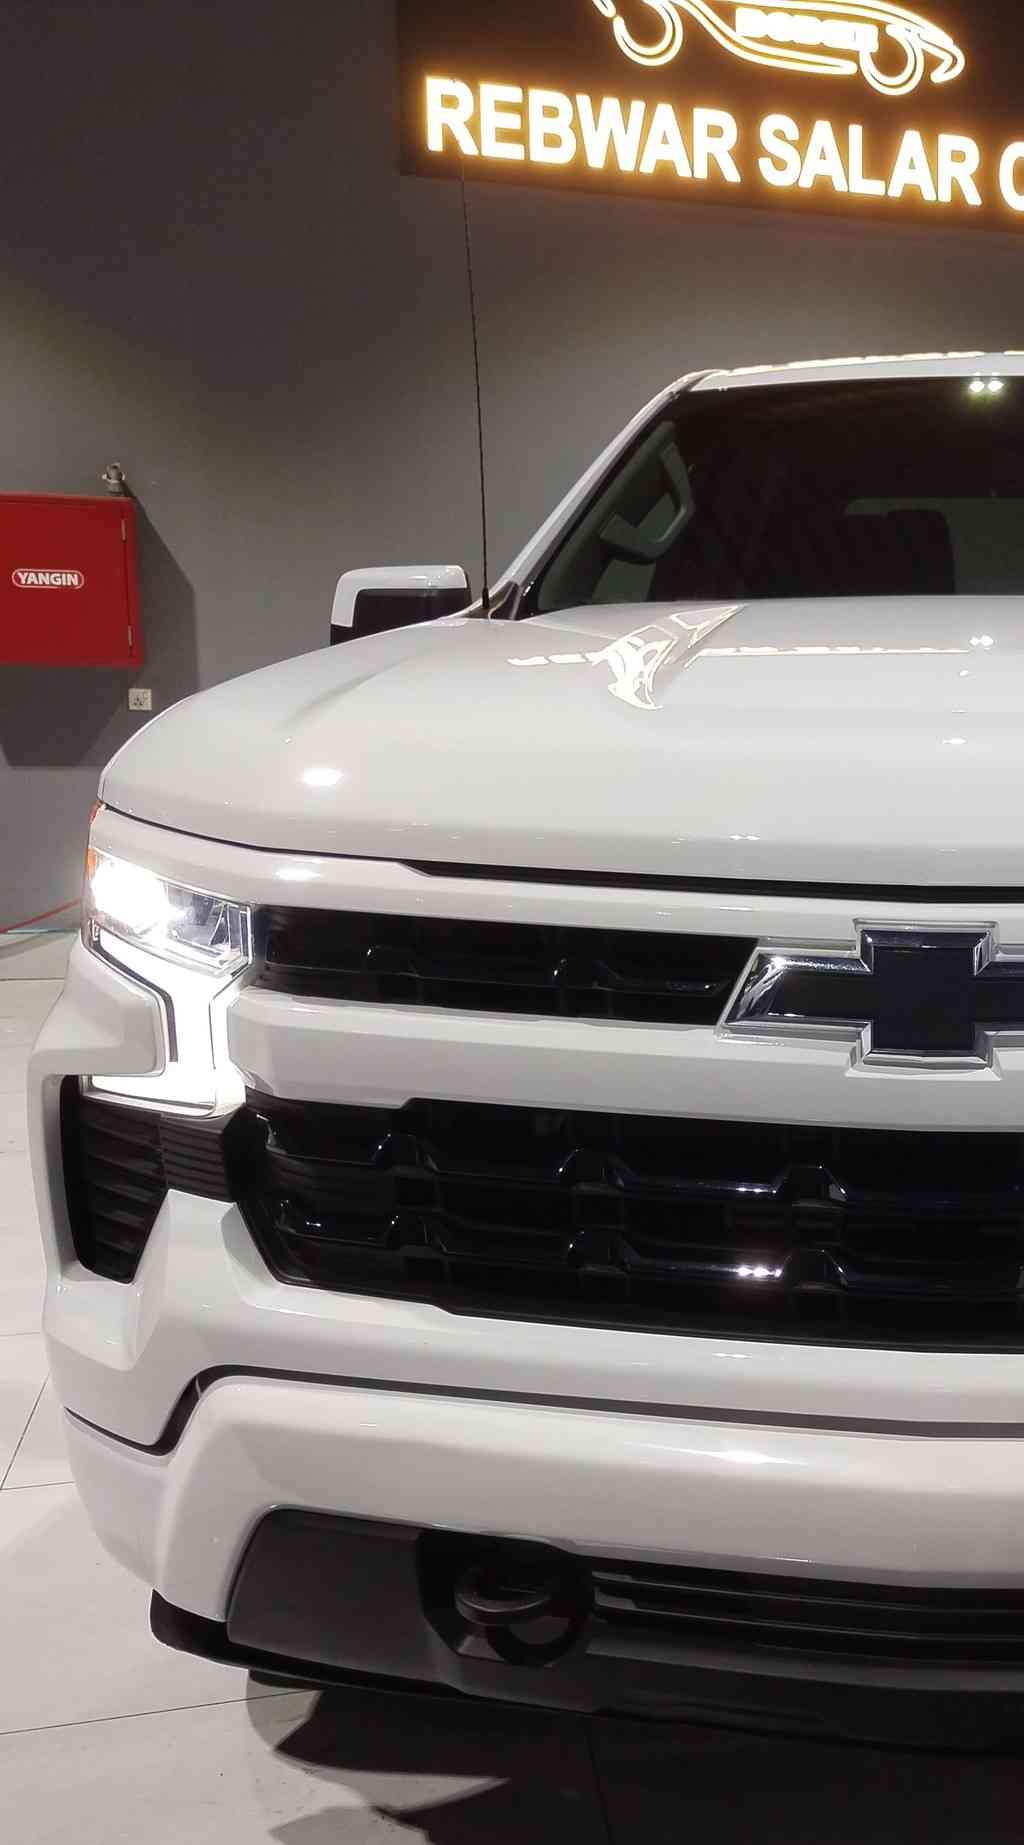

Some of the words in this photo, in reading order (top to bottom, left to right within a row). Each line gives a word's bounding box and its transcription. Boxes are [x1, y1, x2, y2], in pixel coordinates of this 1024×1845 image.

[425, 76, 741, 183] REBWAR
[758, 113, 982, 206] SALAR
[17, 572, 79, 586] YANGIN
